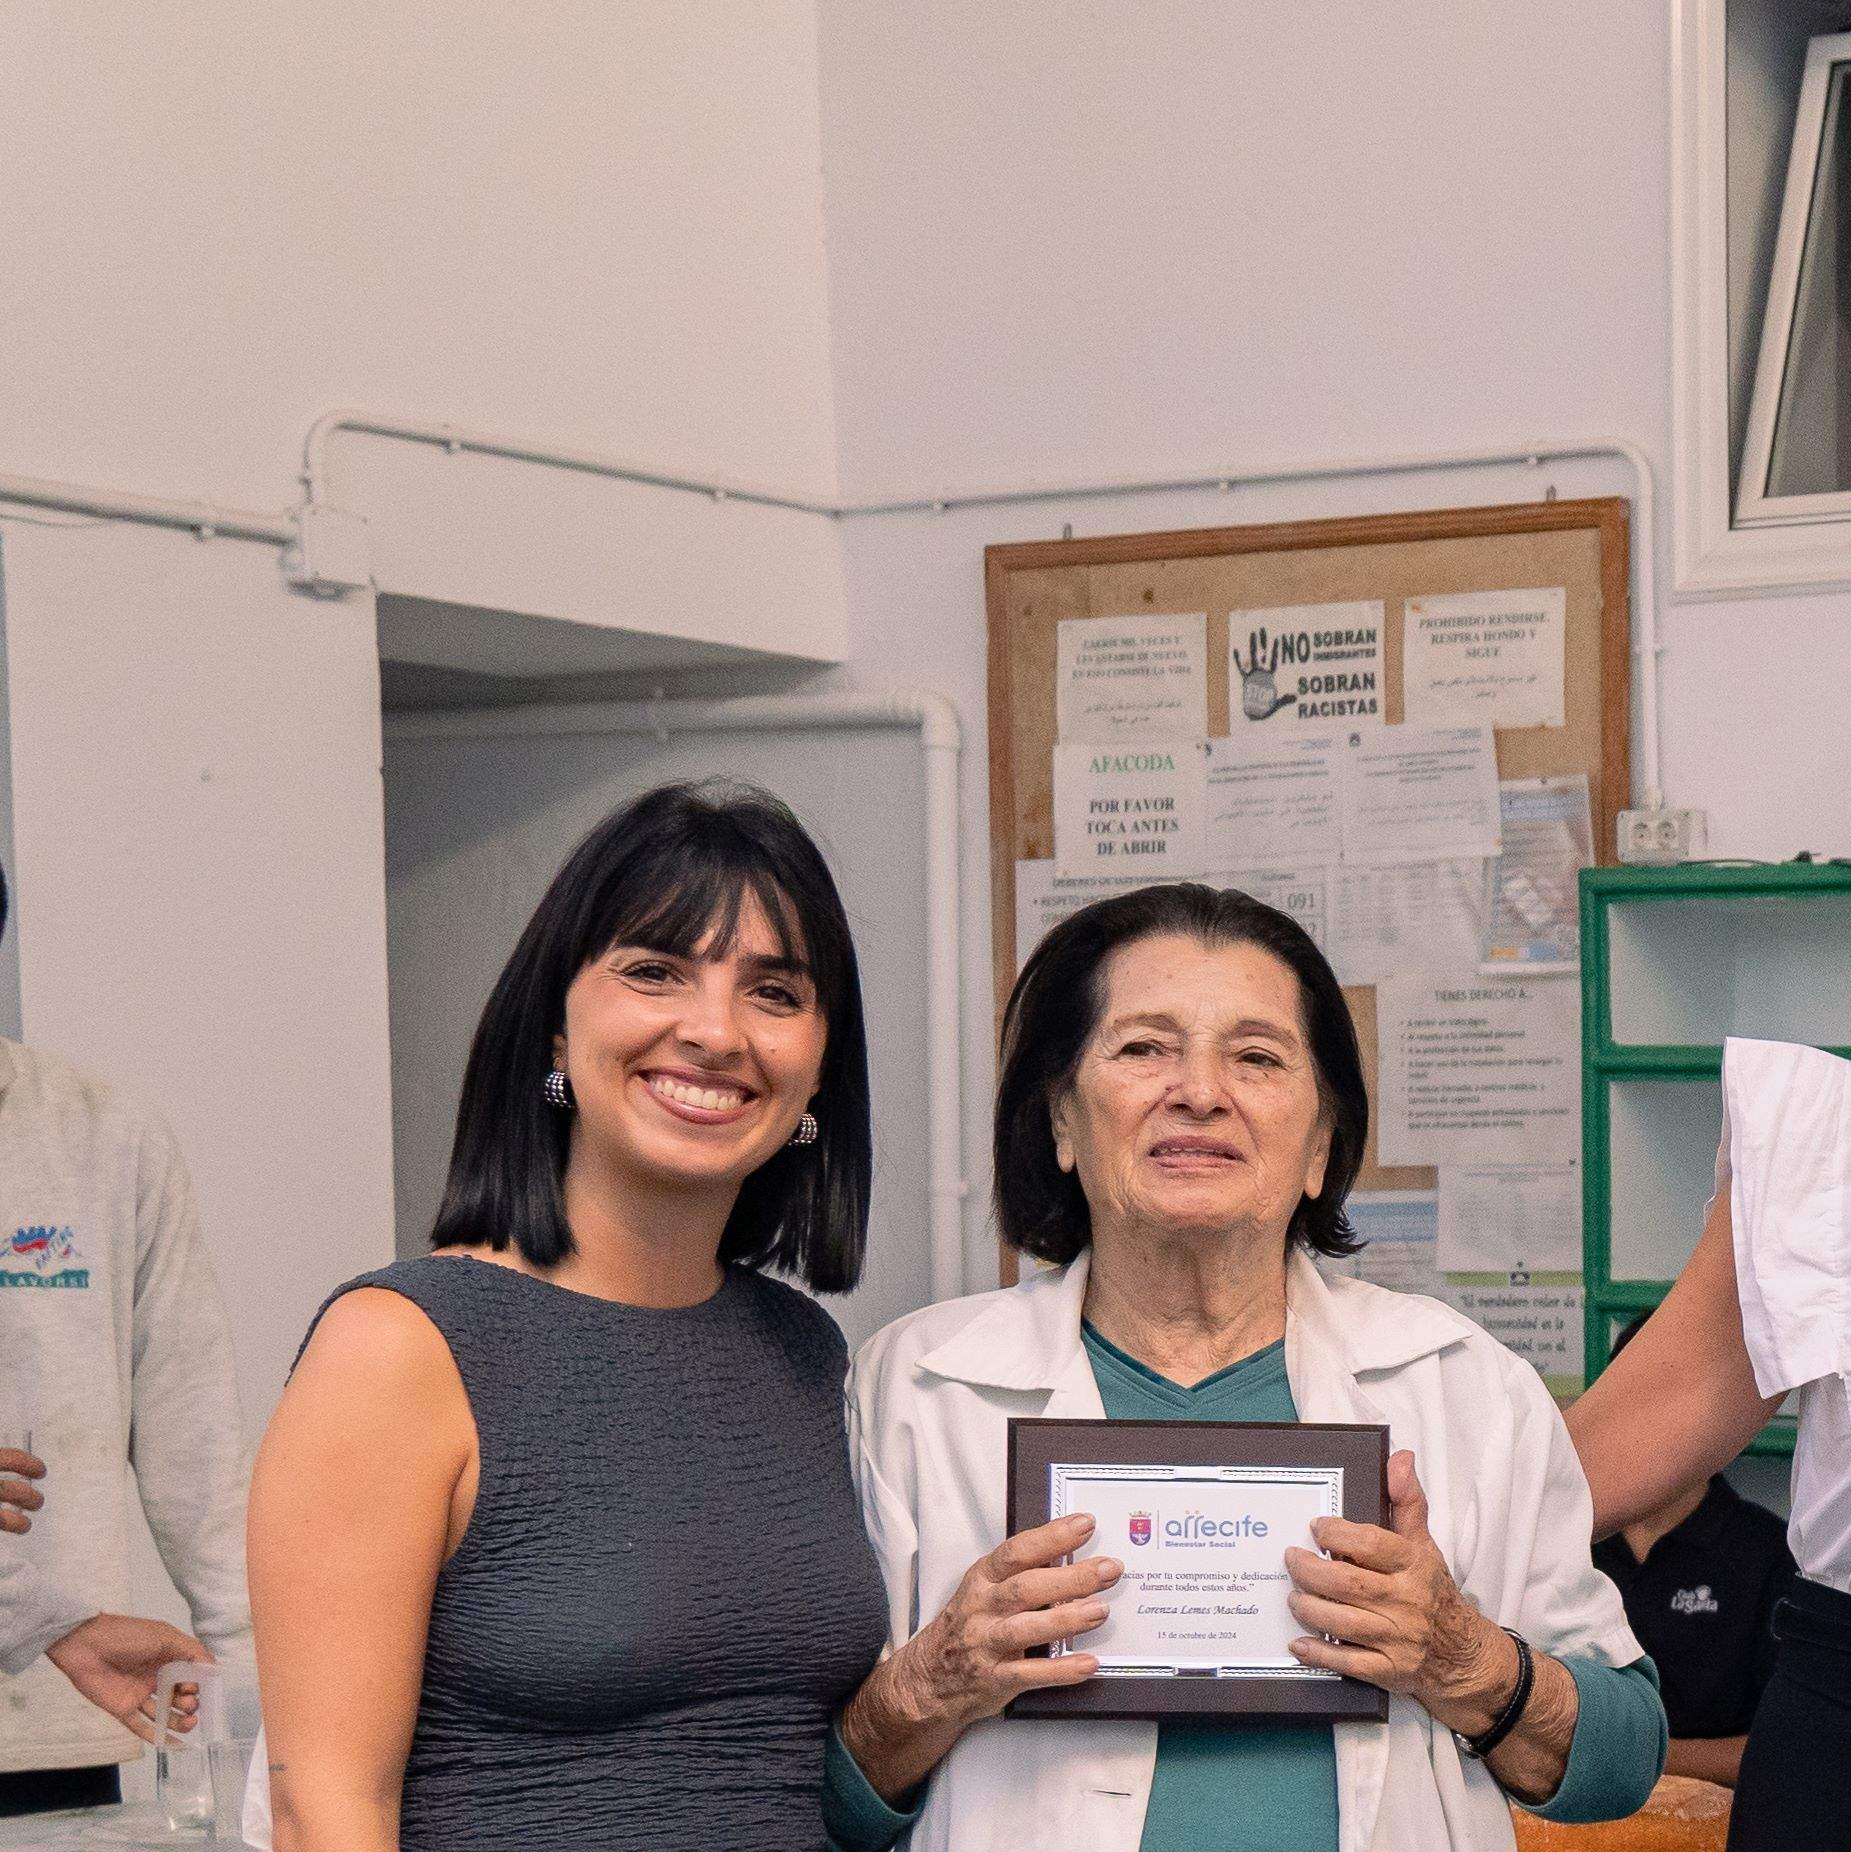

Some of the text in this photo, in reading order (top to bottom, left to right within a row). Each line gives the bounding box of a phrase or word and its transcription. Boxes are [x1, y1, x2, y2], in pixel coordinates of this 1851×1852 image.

[1281, 628, 1377, 664] NO SOBRAN
[1297, 672, 1376, 695] SOBRAN
[1298, 698, 1378, 719] RACISTAS
[1089, 754, 1176, 773] AFACODA
[1090, 797, 1175, 814] POR FAVOR
[1087, 817, 1179, 834] TOCA ANTES
[1097, 840, 1167, 856] DE ABRIR
[1288, 893, 1314, 910] 091
[1435, 990, 1467, 1001] TIENES
[1470, 988, 1516, 1000] DERECHO
[1165, 1510, 1269, 1540] arrecife
[1165, 1540, 1236, 1548] Bienestar Social
[1147, 1572, 1162, 1582] por
[1164, 1572, 1173, 1580] tu
[1175, 1571, 1231, 1582] compromiso
[1233, 1573, 1239, 1583] y
[1139, 1583, 1173, 1592] durante
[1175, 1583, 1200, 1592] todos
[1202, 1584, 1224, 1592] estos
[1137, 1604, 1259, 1615] Lorenza Lemes Machado
[1157, 1631, 1237, 1640] 15 de octubre de 2024
